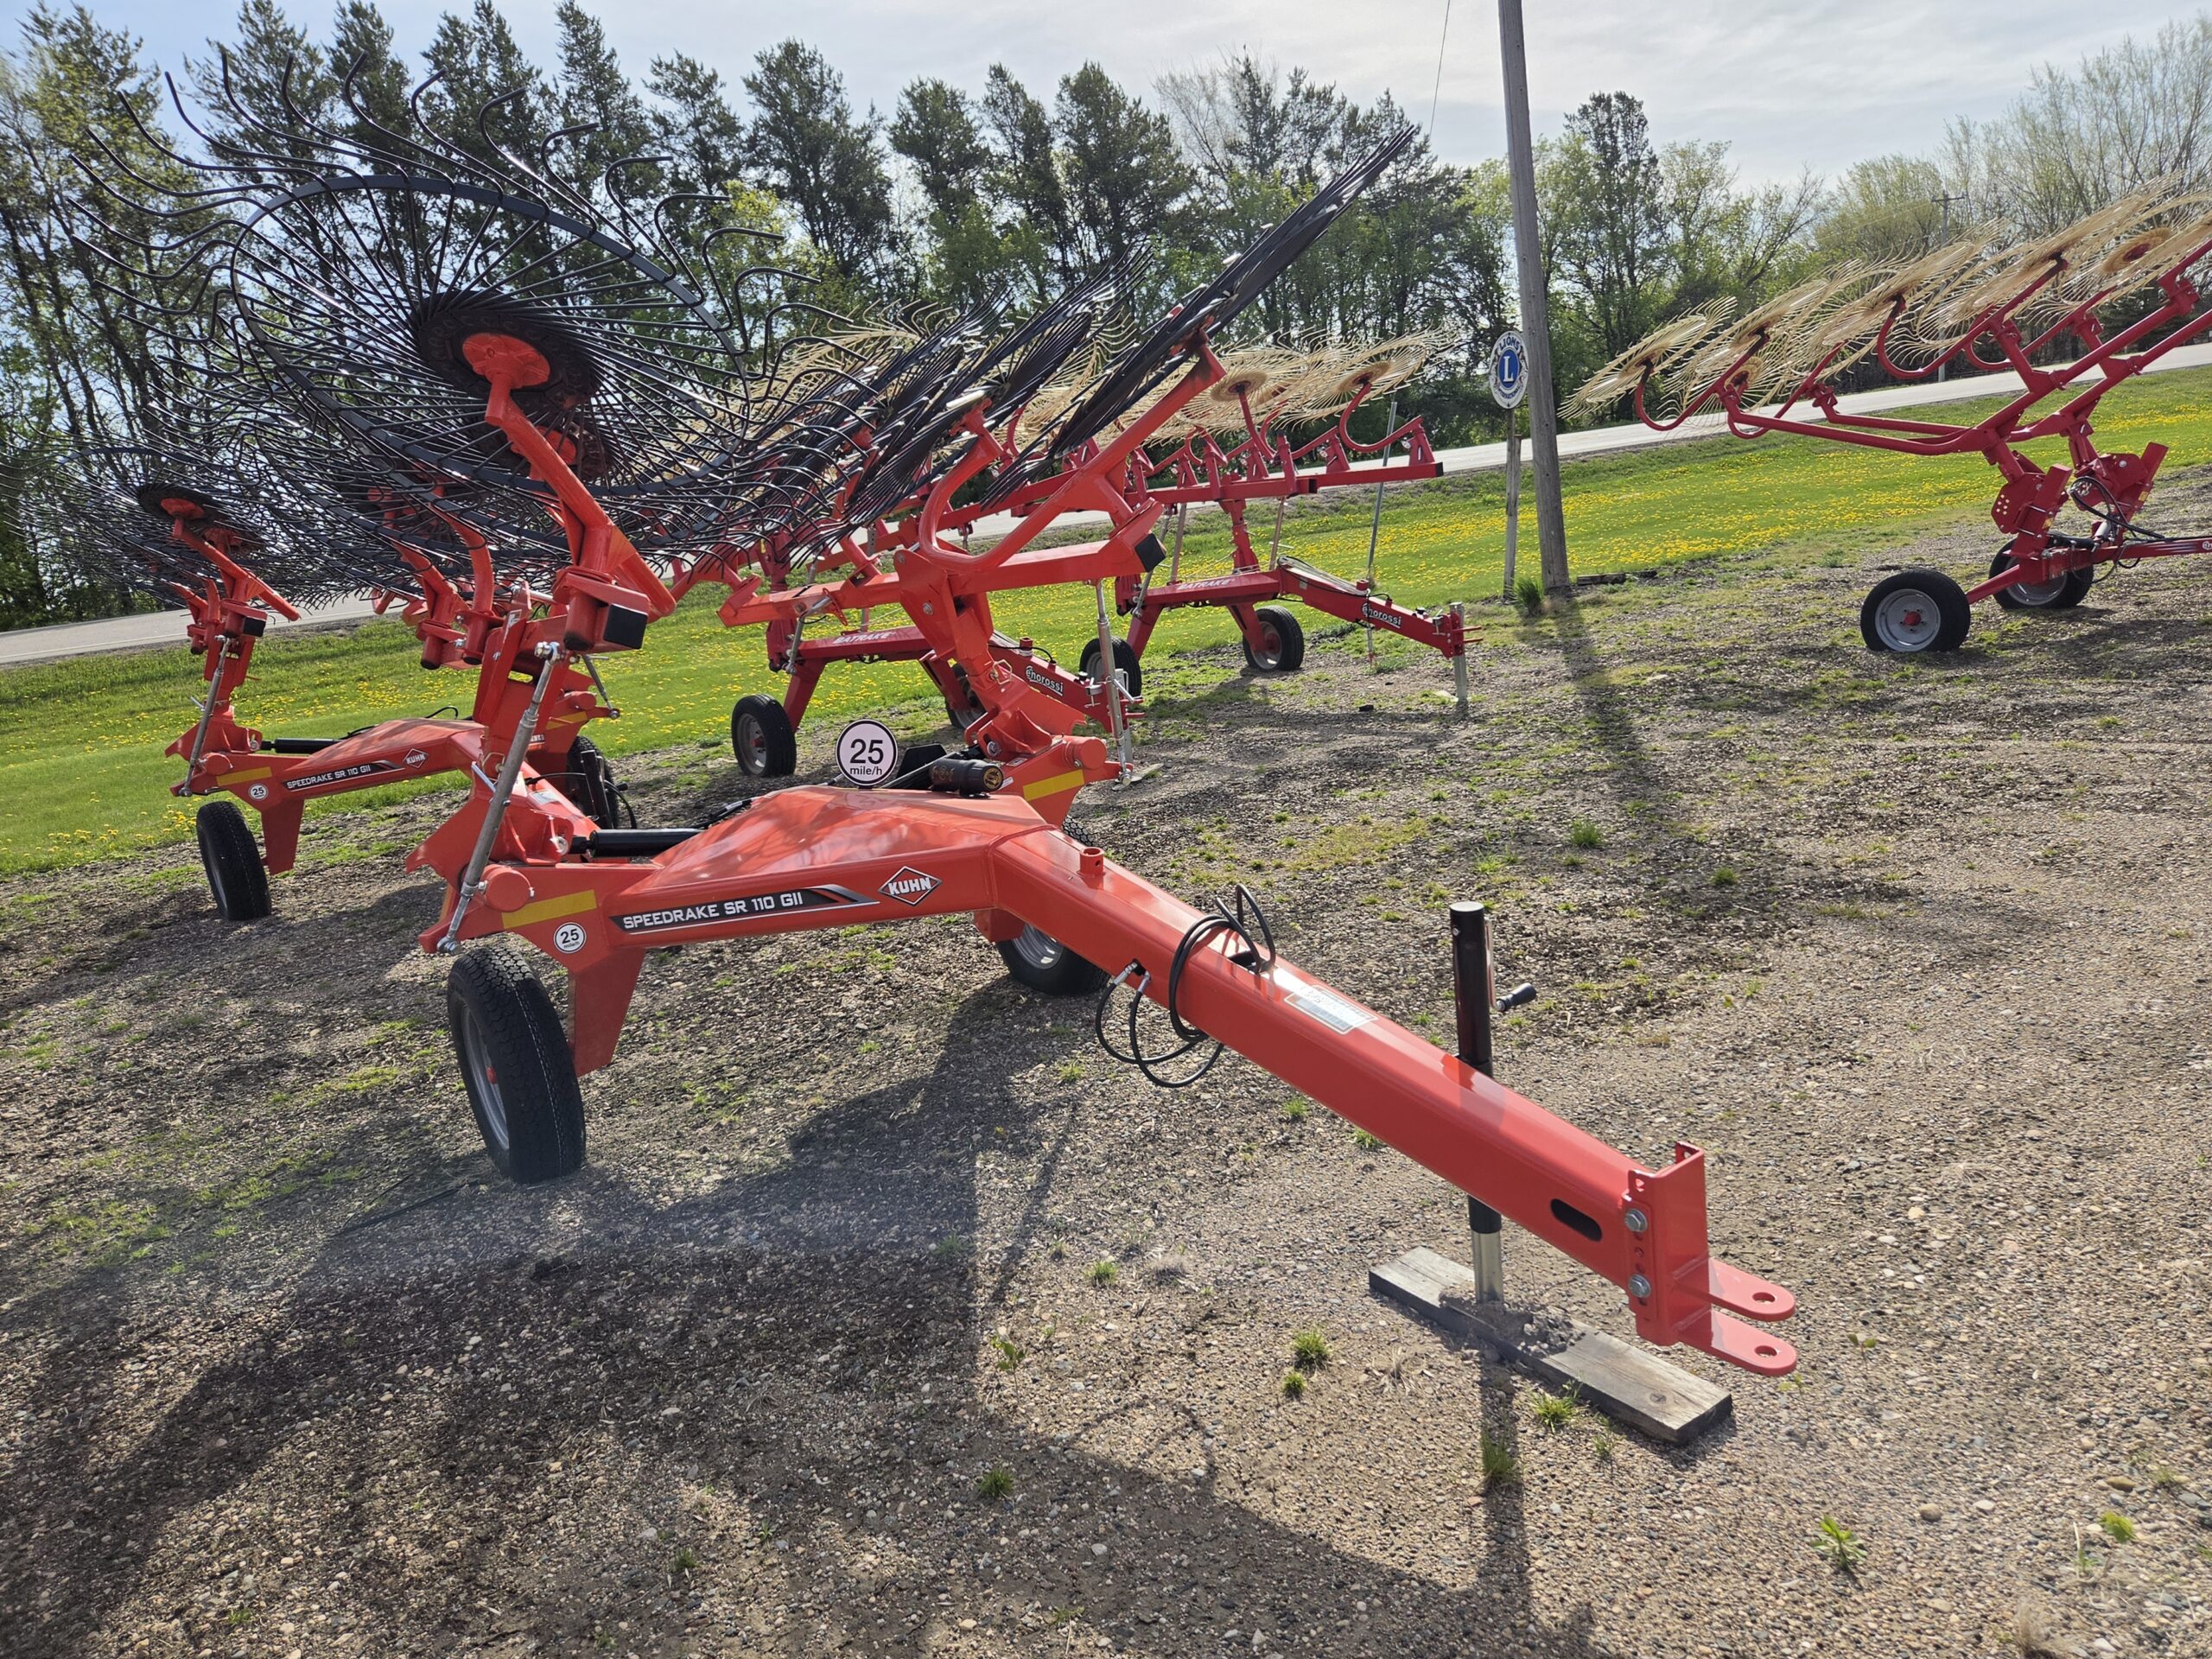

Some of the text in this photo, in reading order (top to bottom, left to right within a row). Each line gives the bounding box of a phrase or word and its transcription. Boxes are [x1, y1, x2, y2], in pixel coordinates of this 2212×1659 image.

[1499, 336, 1521, 351] LIONS
[1503, 356, 1514, 382] L
[1026, 666, 1064, 693] enorossi
[406, 753, 426, 765] KUHN
[850, 738, 884, 765] 25
[286, 765, 372, 790] SPEEDRAKE SR 110 GII
[849, 766, 883, 776] mile/h
[252, 787, 264, 796] 25
[887, 876, 932, 896] KUHN
[623, 892, 804, 930] SPEEDRAKE SR 110 GII
[560, 928, 580, 944] 25
